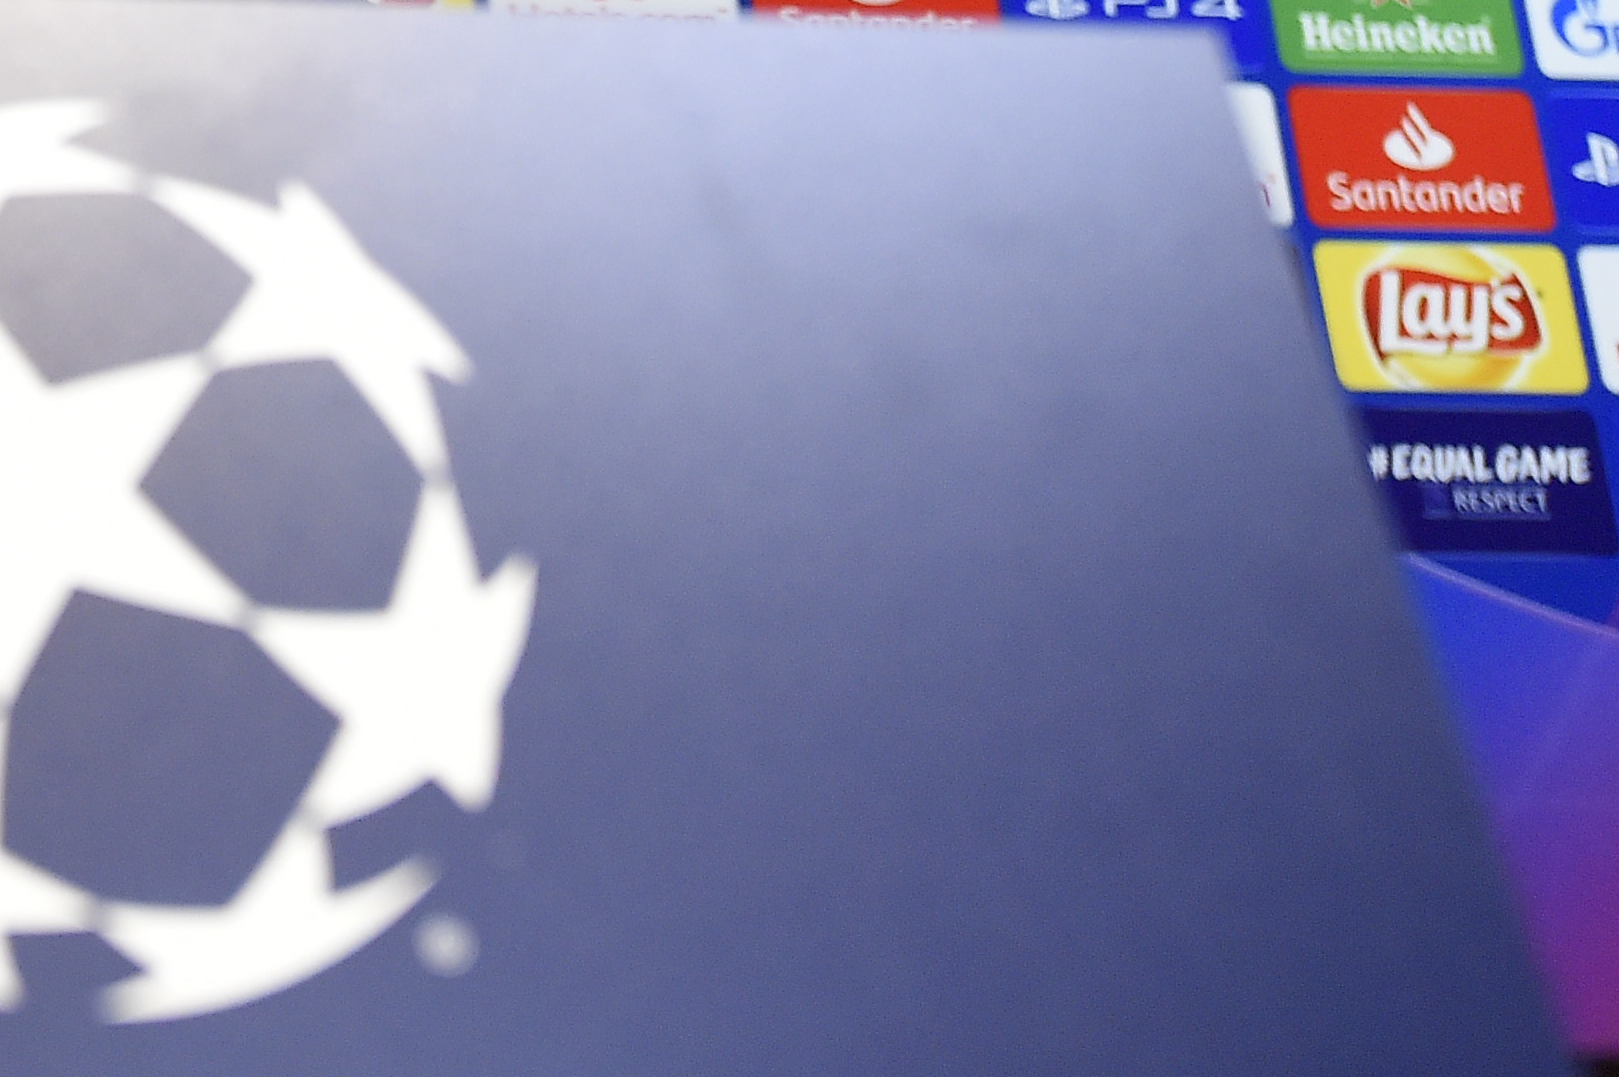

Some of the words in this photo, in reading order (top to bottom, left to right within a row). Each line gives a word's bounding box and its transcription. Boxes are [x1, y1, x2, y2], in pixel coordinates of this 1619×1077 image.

[1297, 11, 1498, 55] Heineken
[1327, 171, 1525, 215] Santander
[1380, 269, 1525, 355] Lay's
[1495, 444, 1591, 485] GAME
